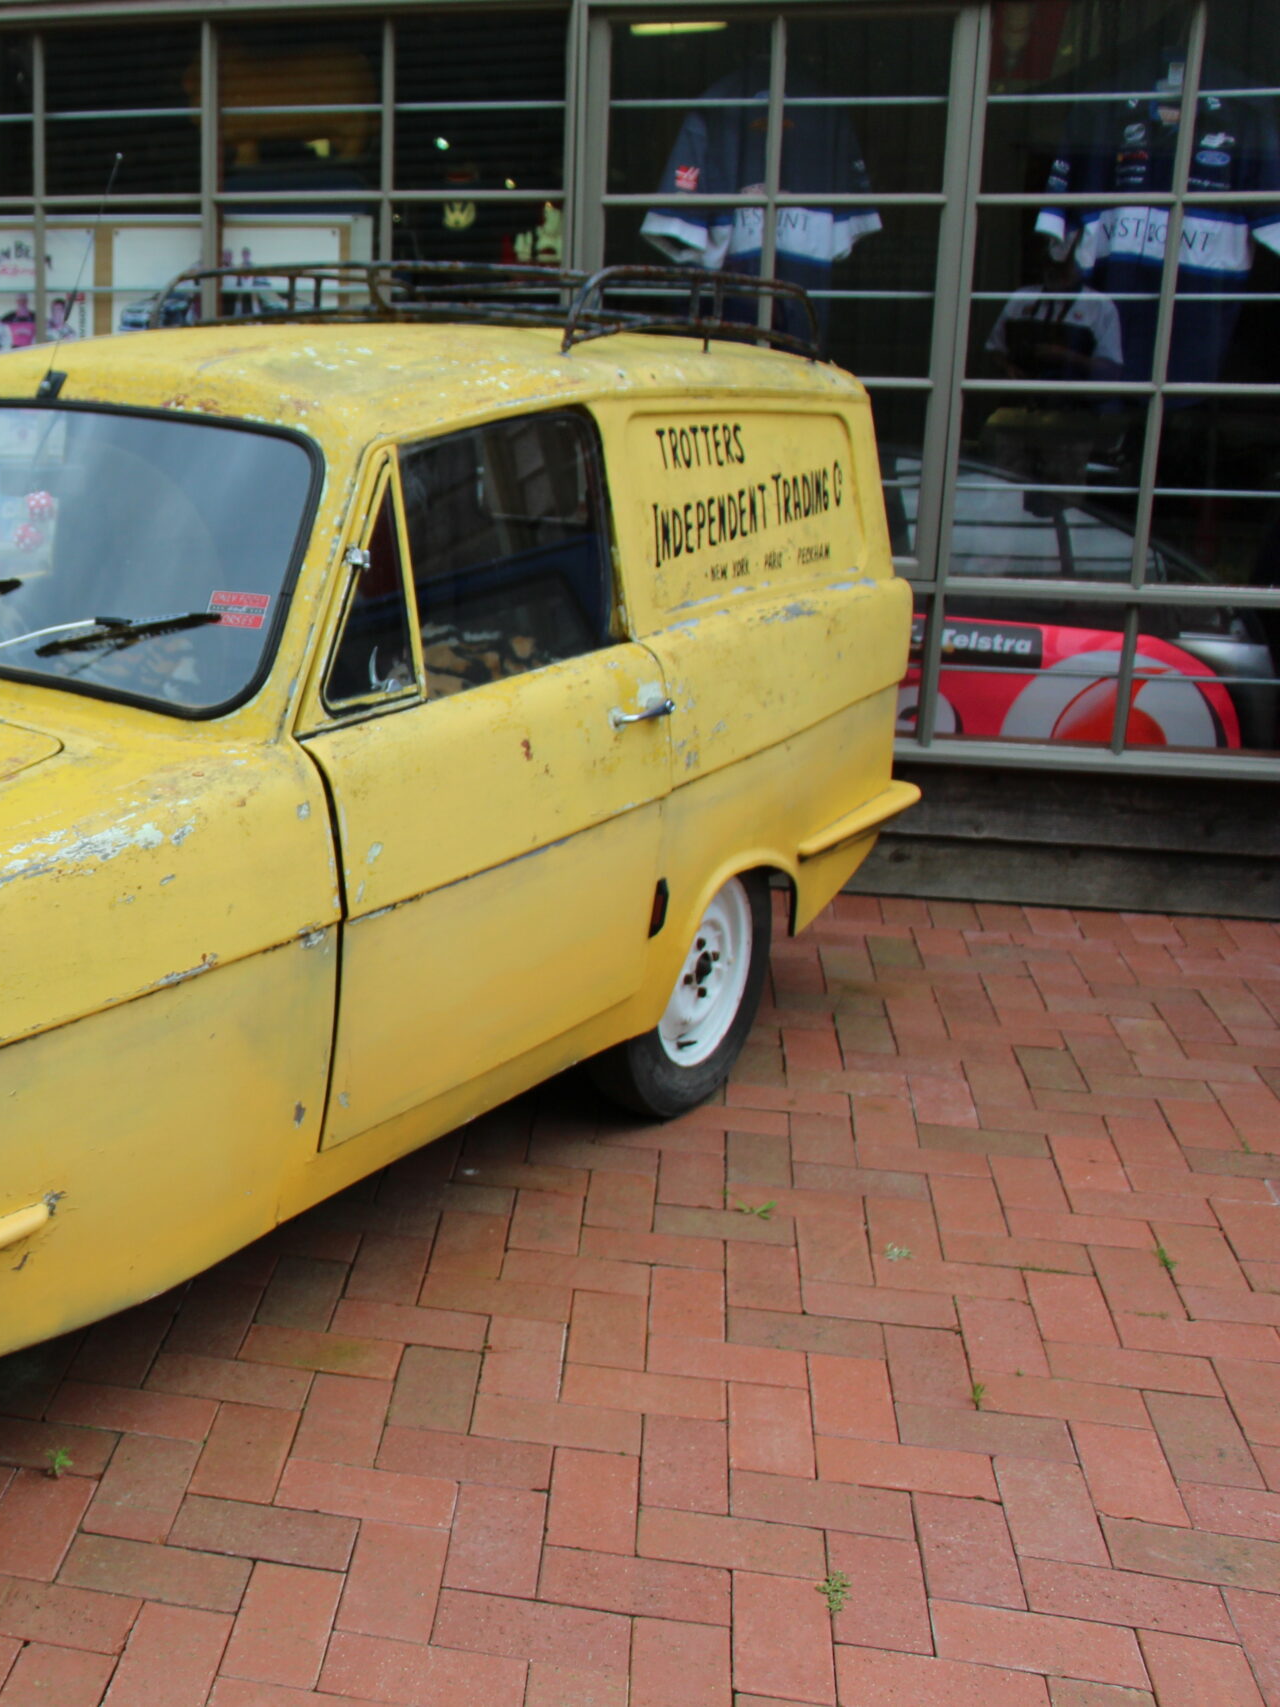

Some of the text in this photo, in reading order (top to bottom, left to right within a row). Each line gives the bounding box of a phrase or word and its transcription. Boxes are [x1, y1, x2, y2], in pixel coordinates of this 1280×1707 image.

[655, 423, 745, 470] TROTTERS
[652, 483, 767, 568] INDEPENDENT
[771, 467, 829, 526] TRADING
[710, 562, 728, 582] NEW
[732, 556, 750, 579] YORK
[797, 543, 831, 566] PECKHAM
[941, 628, 1033, 655] Telstra
